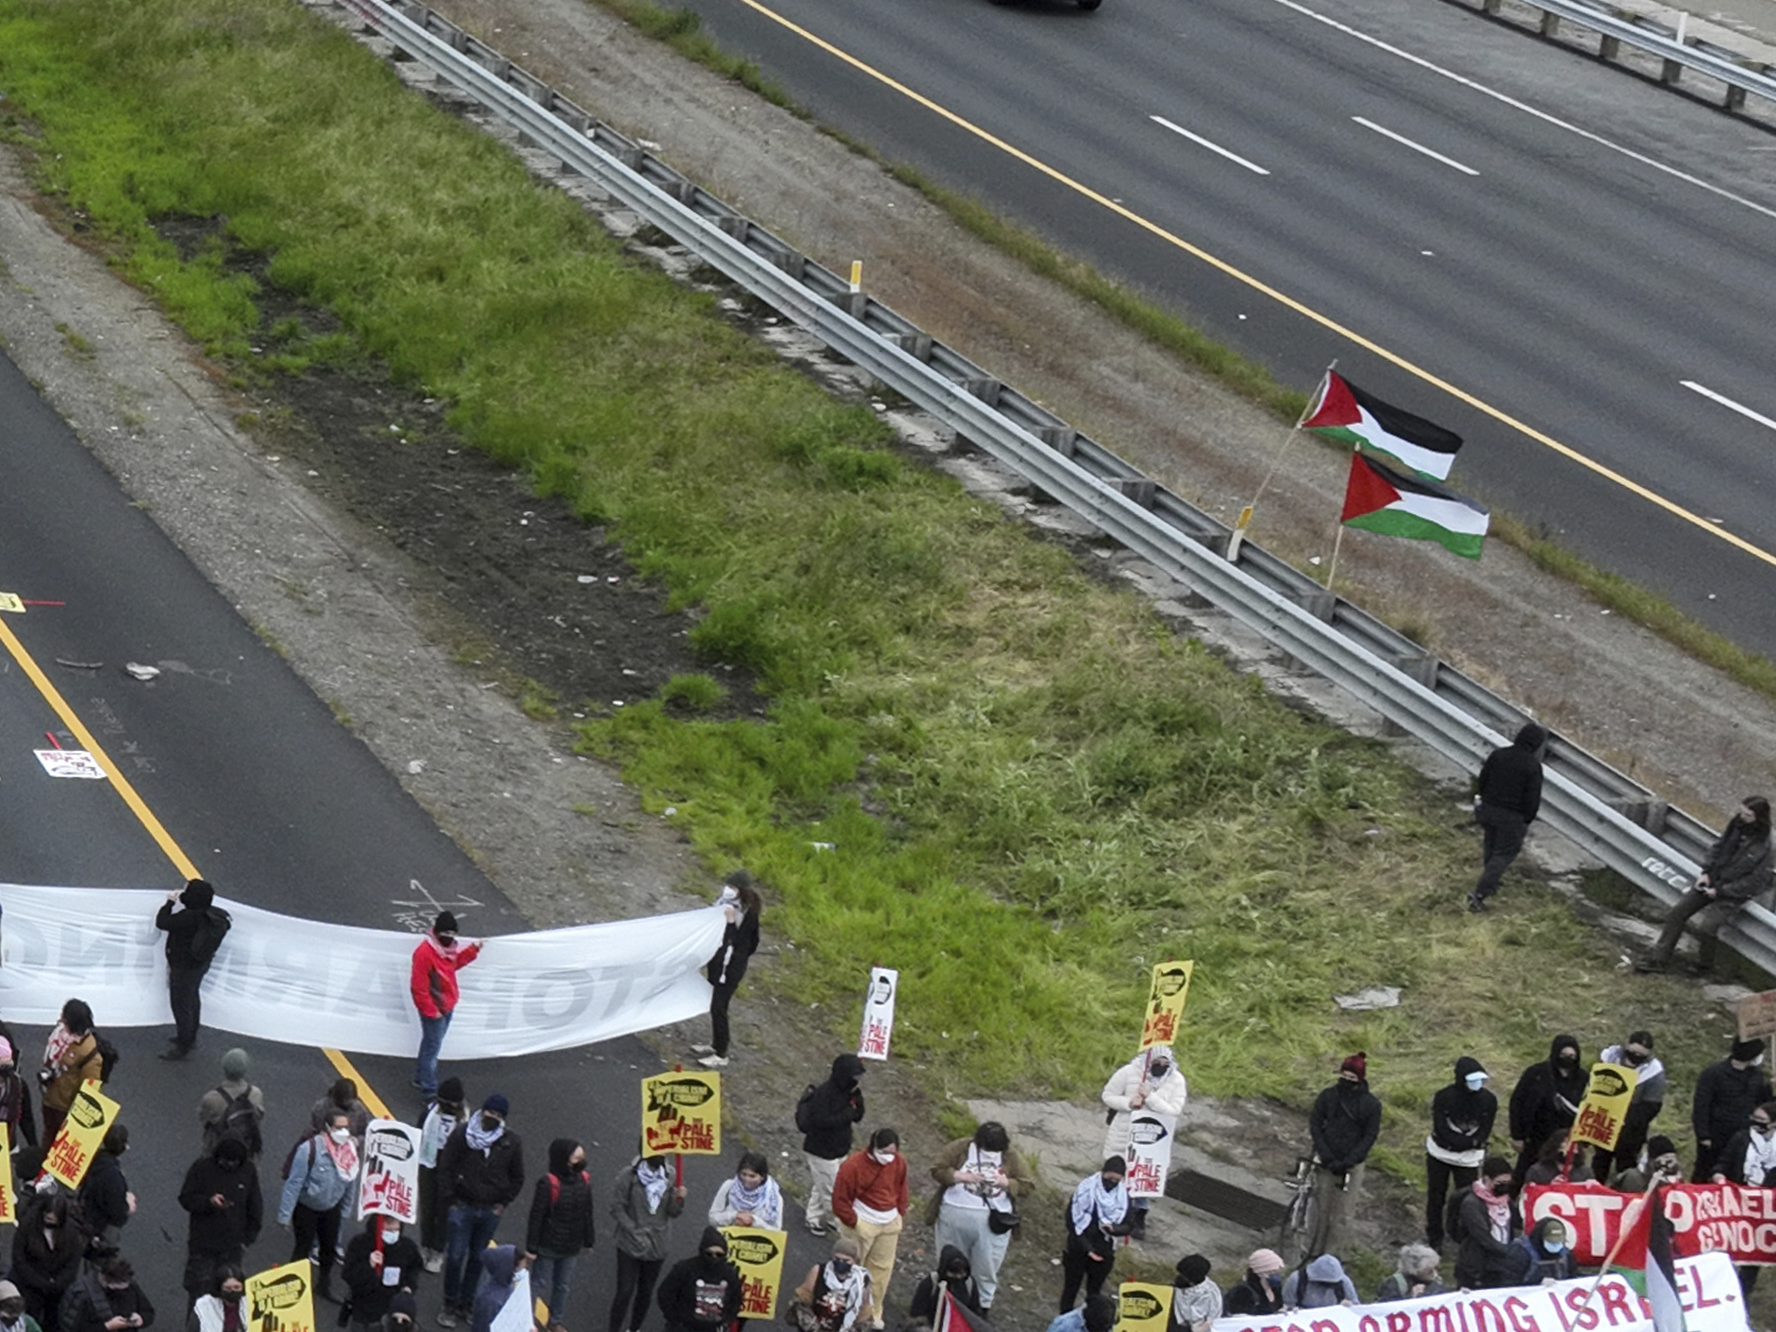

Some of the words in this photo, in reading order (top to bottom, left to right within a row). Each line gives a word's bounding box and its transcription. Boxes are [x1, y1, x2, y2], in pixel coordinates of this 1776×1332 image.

[684, 1124, 714, 1138] PALE
[680, 1136, 715, 1151] STINE
[61, 1144, 86, 1166] PALE
[51, 1156, 81, 1183] STINE
